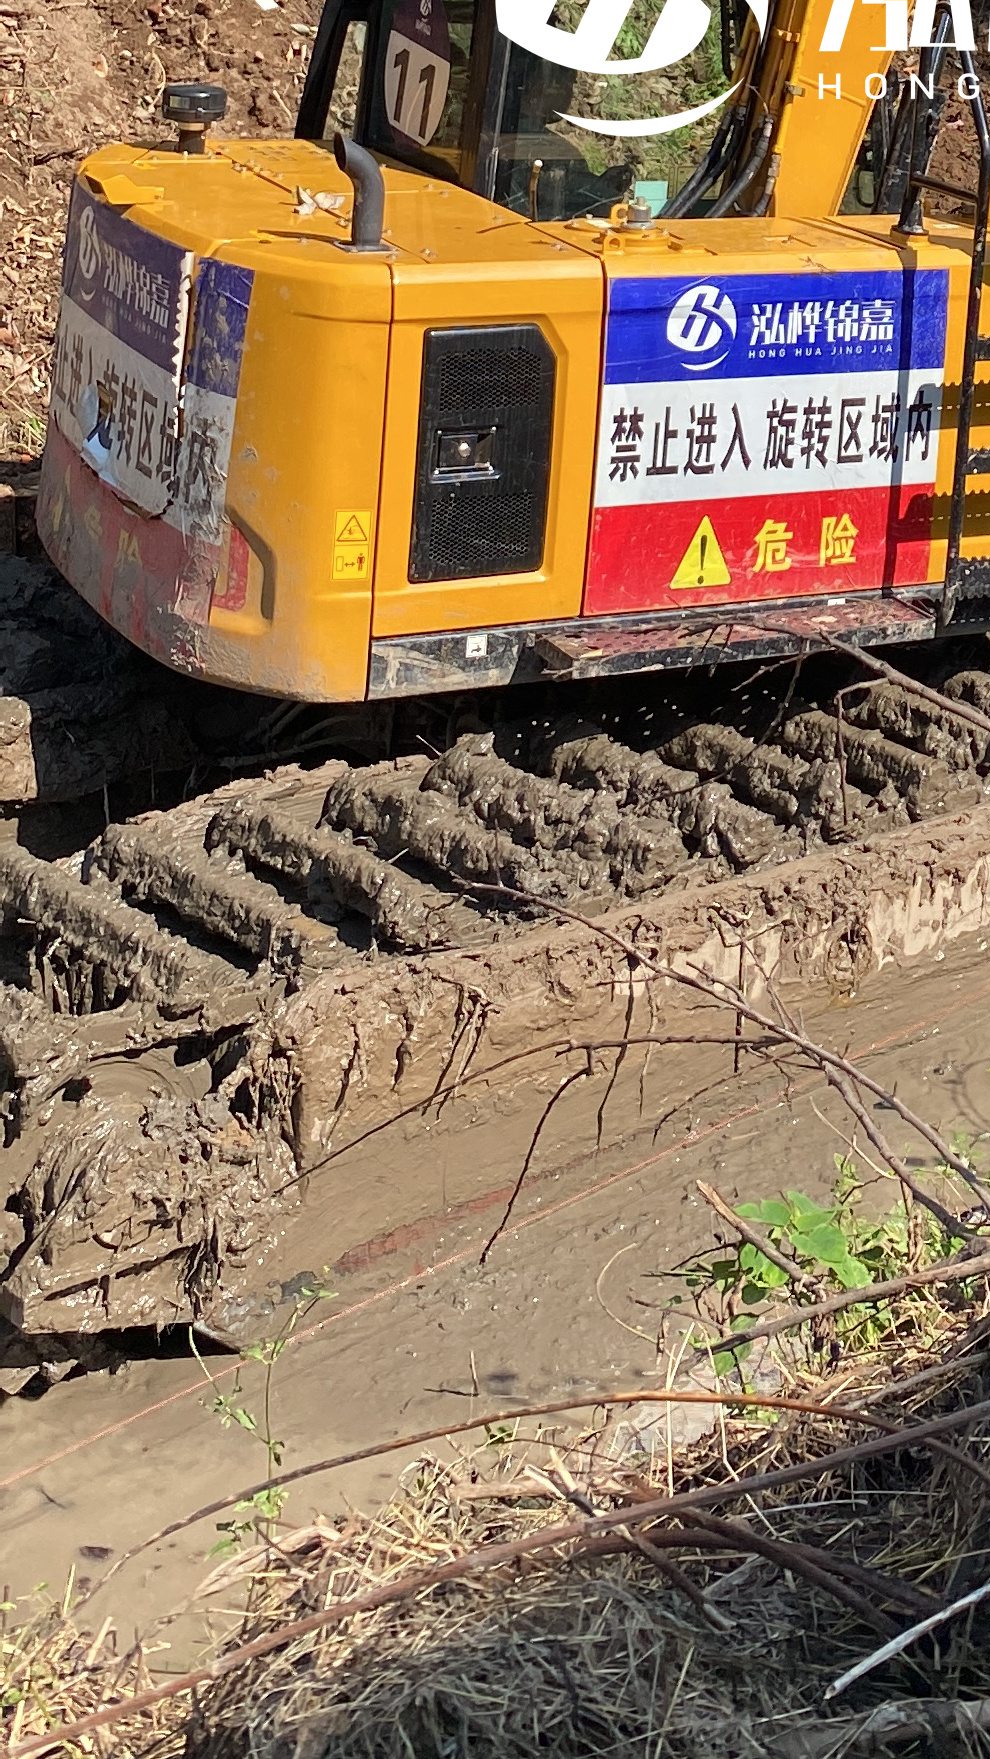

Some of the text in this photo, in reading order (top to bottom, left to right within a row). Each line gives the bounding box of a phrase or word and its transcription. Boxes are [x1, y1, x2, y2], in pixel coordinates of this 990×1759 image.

[394, 49, 436, 139] 11
[749, 299, 896, 346] 泓桦锦嘉
[748, 344, 893, 359] HONG HUA JING JIA
[753, 513, 858, 573] 危险
